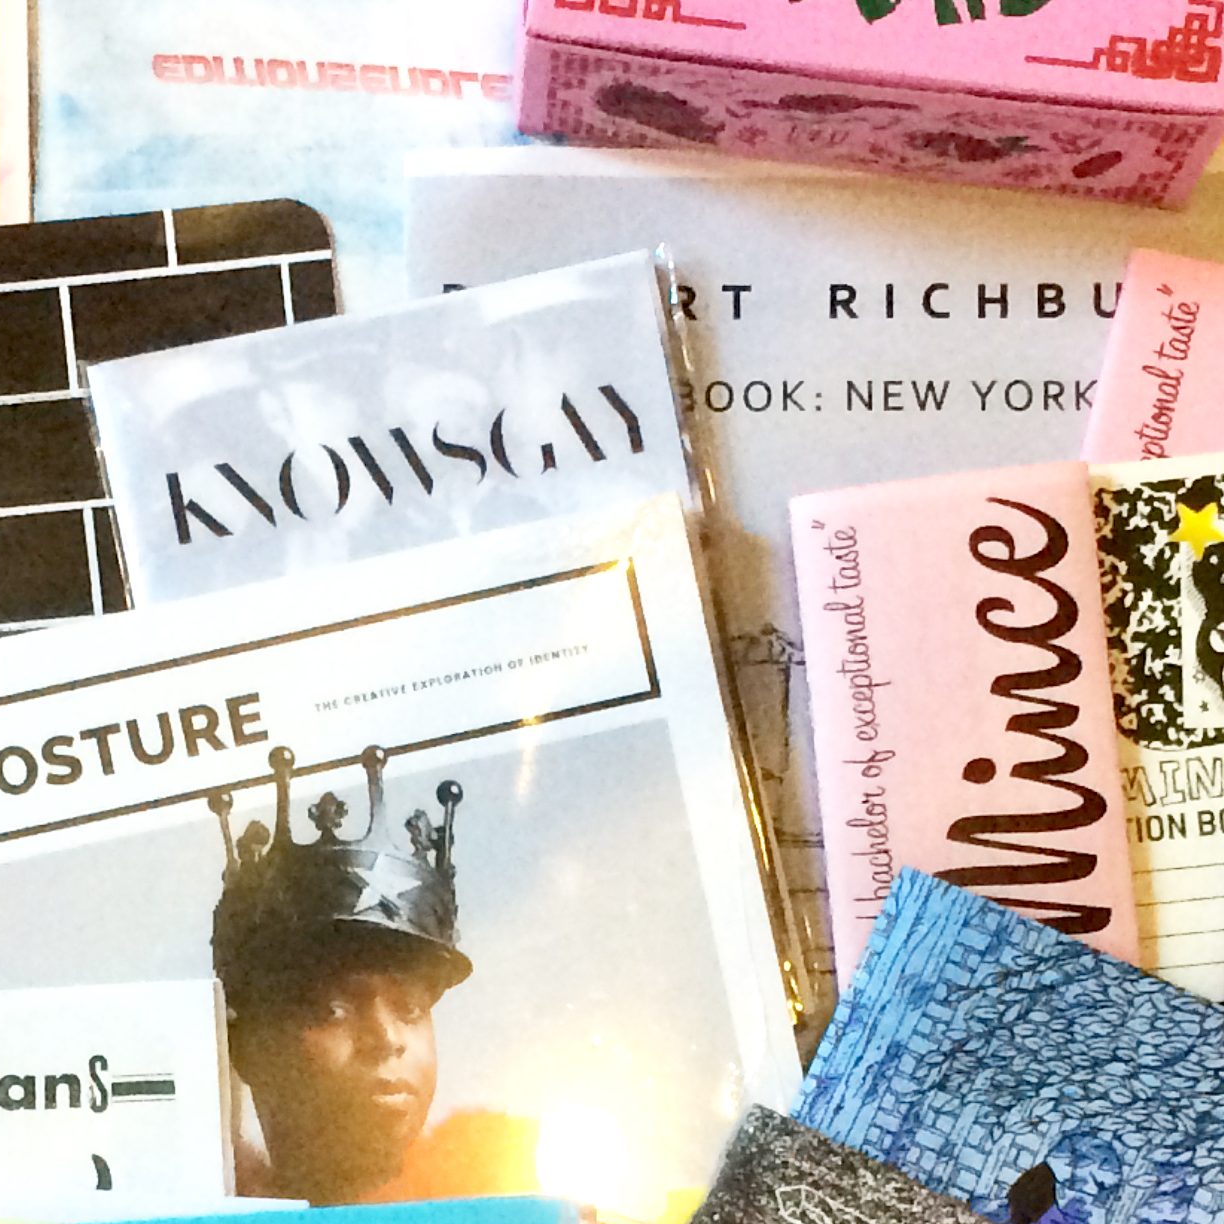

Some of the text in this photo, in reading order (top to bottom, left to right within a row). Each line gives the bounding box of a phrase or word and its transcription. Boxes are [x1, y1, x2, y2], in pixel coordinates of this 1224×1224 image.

[846, 380, 950, 412] NEW
[972, 380, 1095, 412] YORK
[315, 699, 339, 714] THE
[343, 683, 407, 707] CREATIVE
[411, 662, 503, 692] EXPLORATION
[507, 657, 525, 671] OF
[823, 595, 892, 742] exceptional
[842, 750, 896, 778] of
